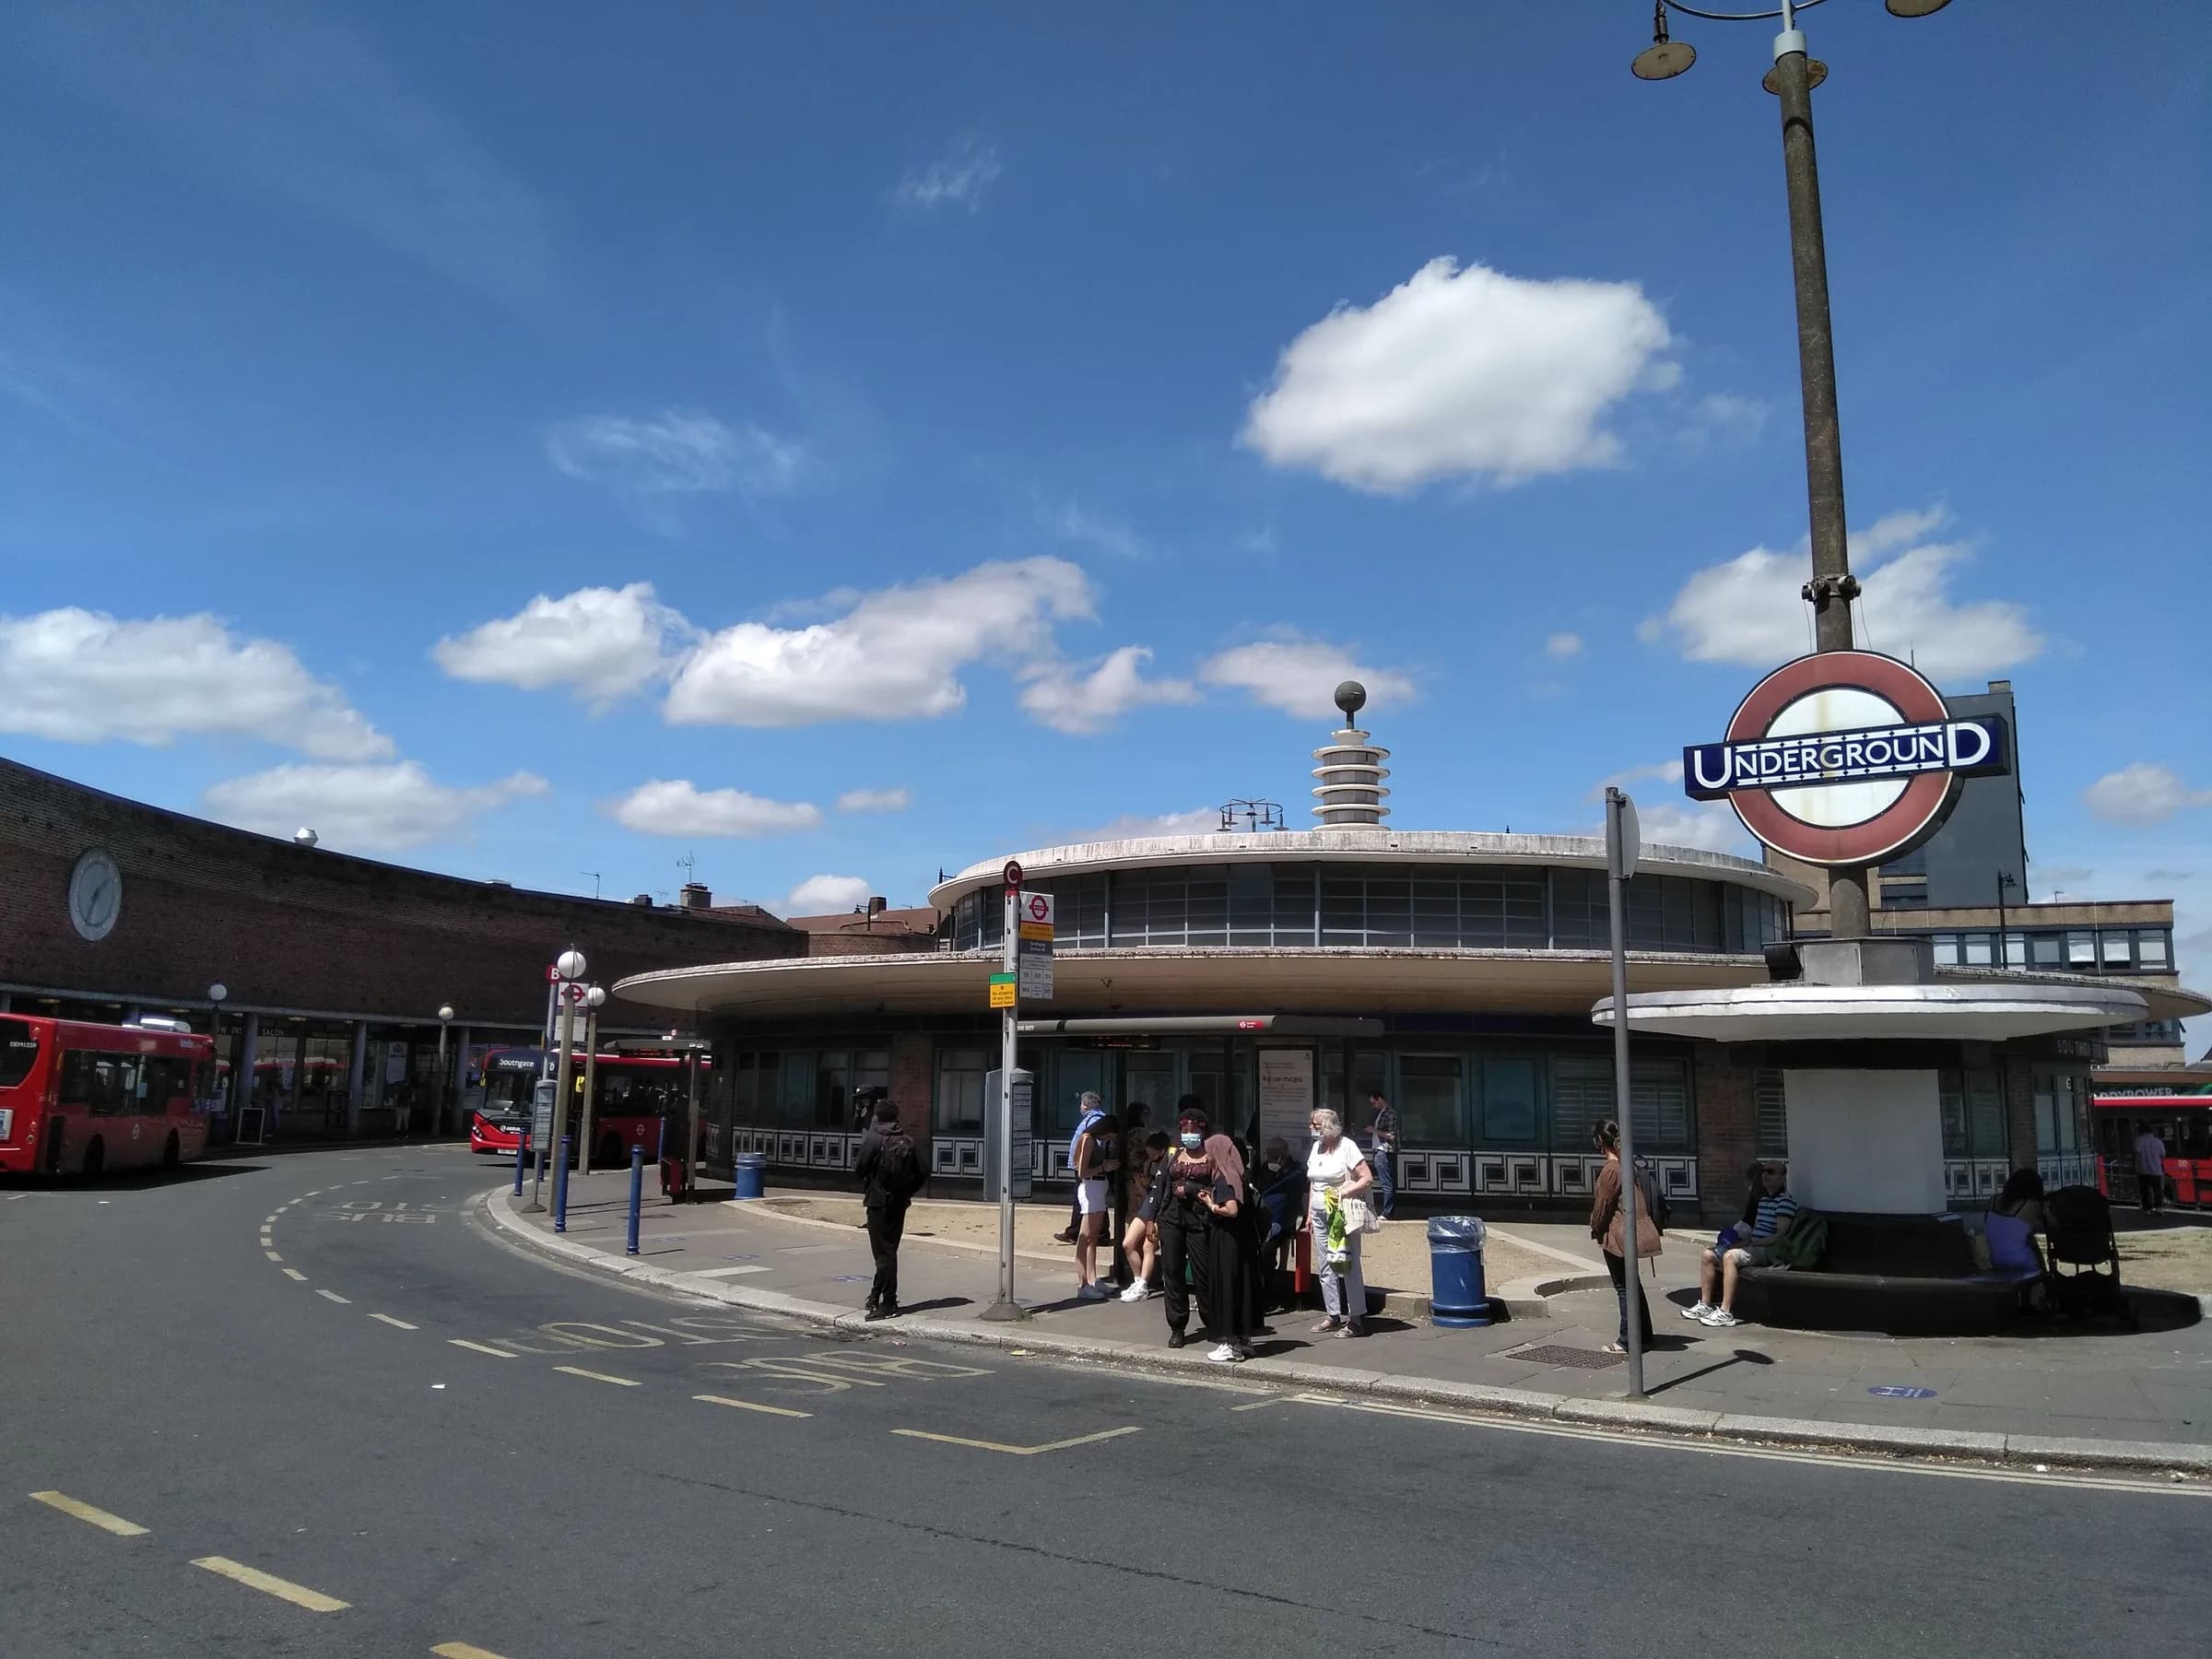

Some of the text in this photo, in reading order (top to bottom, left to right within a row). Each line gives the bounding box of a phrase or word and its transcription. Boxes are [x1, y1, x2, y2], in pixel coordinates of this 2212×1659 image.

[1694, 722, 1991, 789] UNDERGROUND
[1006, 865, 1018, 885] C
[550, 968, 560, 980] B
[500, 1059, 535, 1069] Southgate
[693, 1349, 997, 1394] BUS
